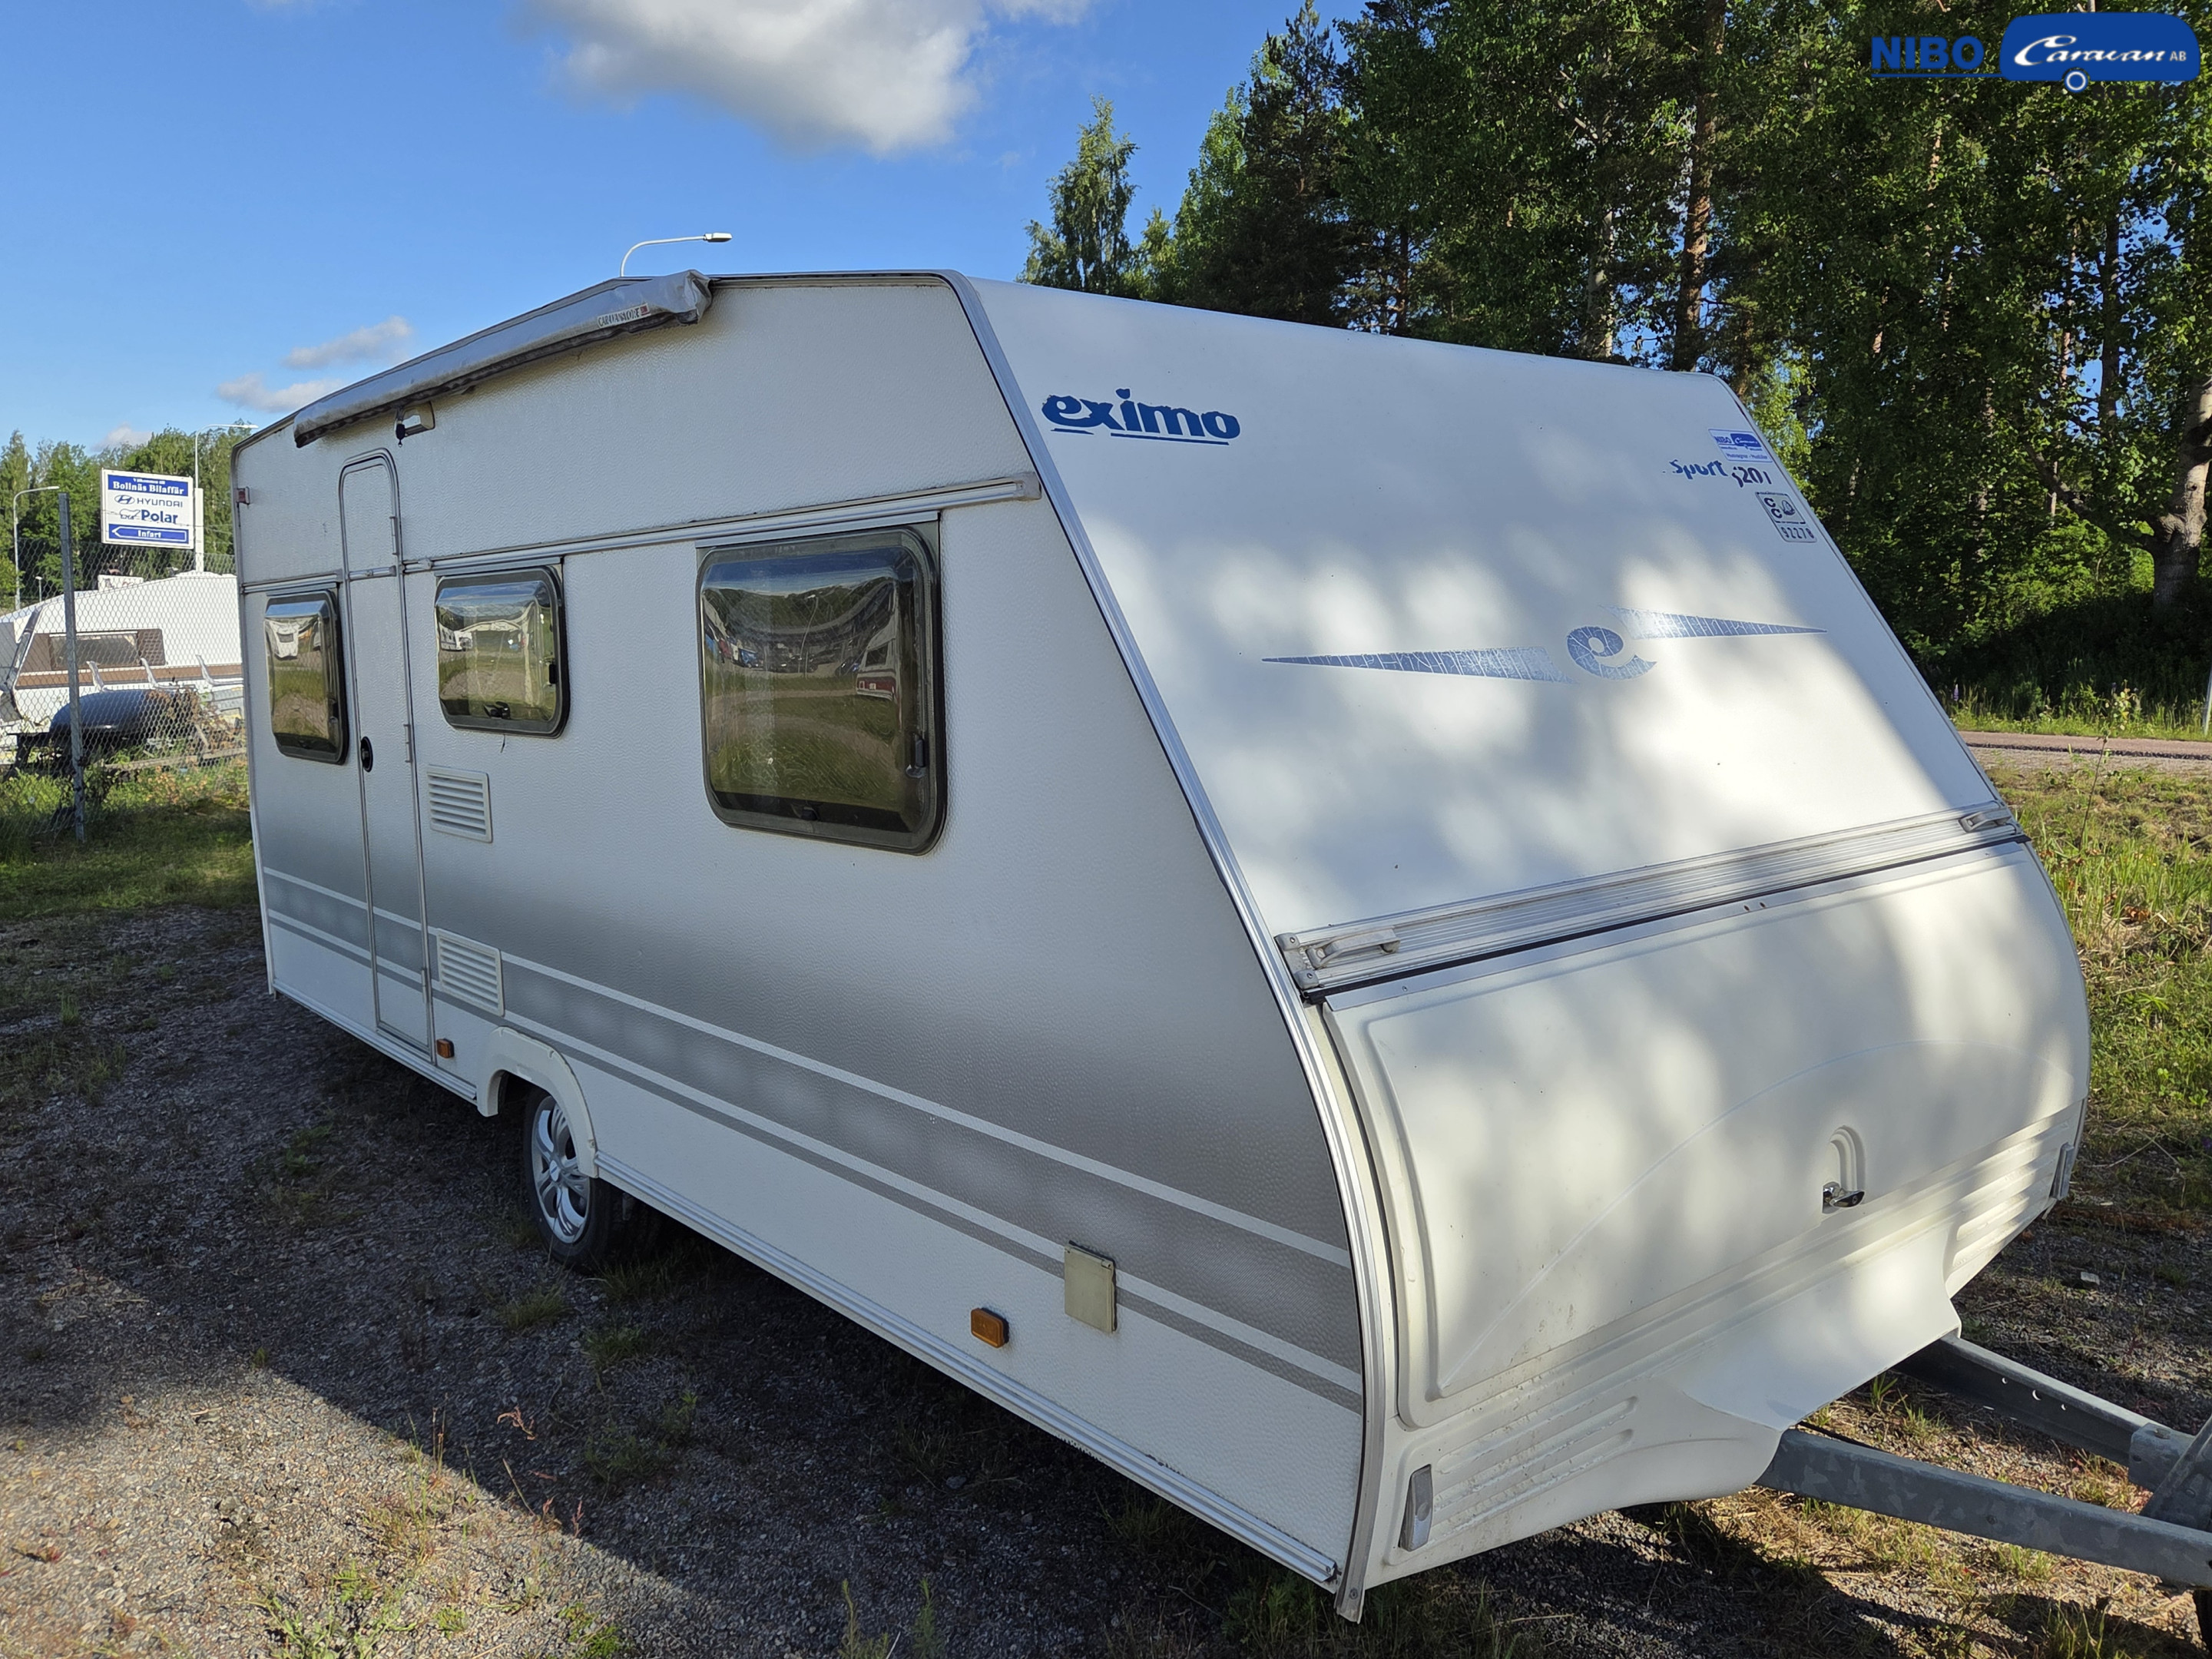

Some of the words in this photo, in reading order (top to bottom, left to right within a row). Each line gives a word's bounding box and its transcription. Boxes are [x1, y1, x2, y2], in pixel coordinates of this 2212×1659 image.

[1041, 388, 1240, 439] eximo
[1669, 459, 1728, 479] Sport
[113, 481, 147, 492] Bollnäs
[149, 485, 184, 495] Bilaffär
[137, 498, 183, 508] HYUNDAI
[141, 509, 178, 524] Polar
